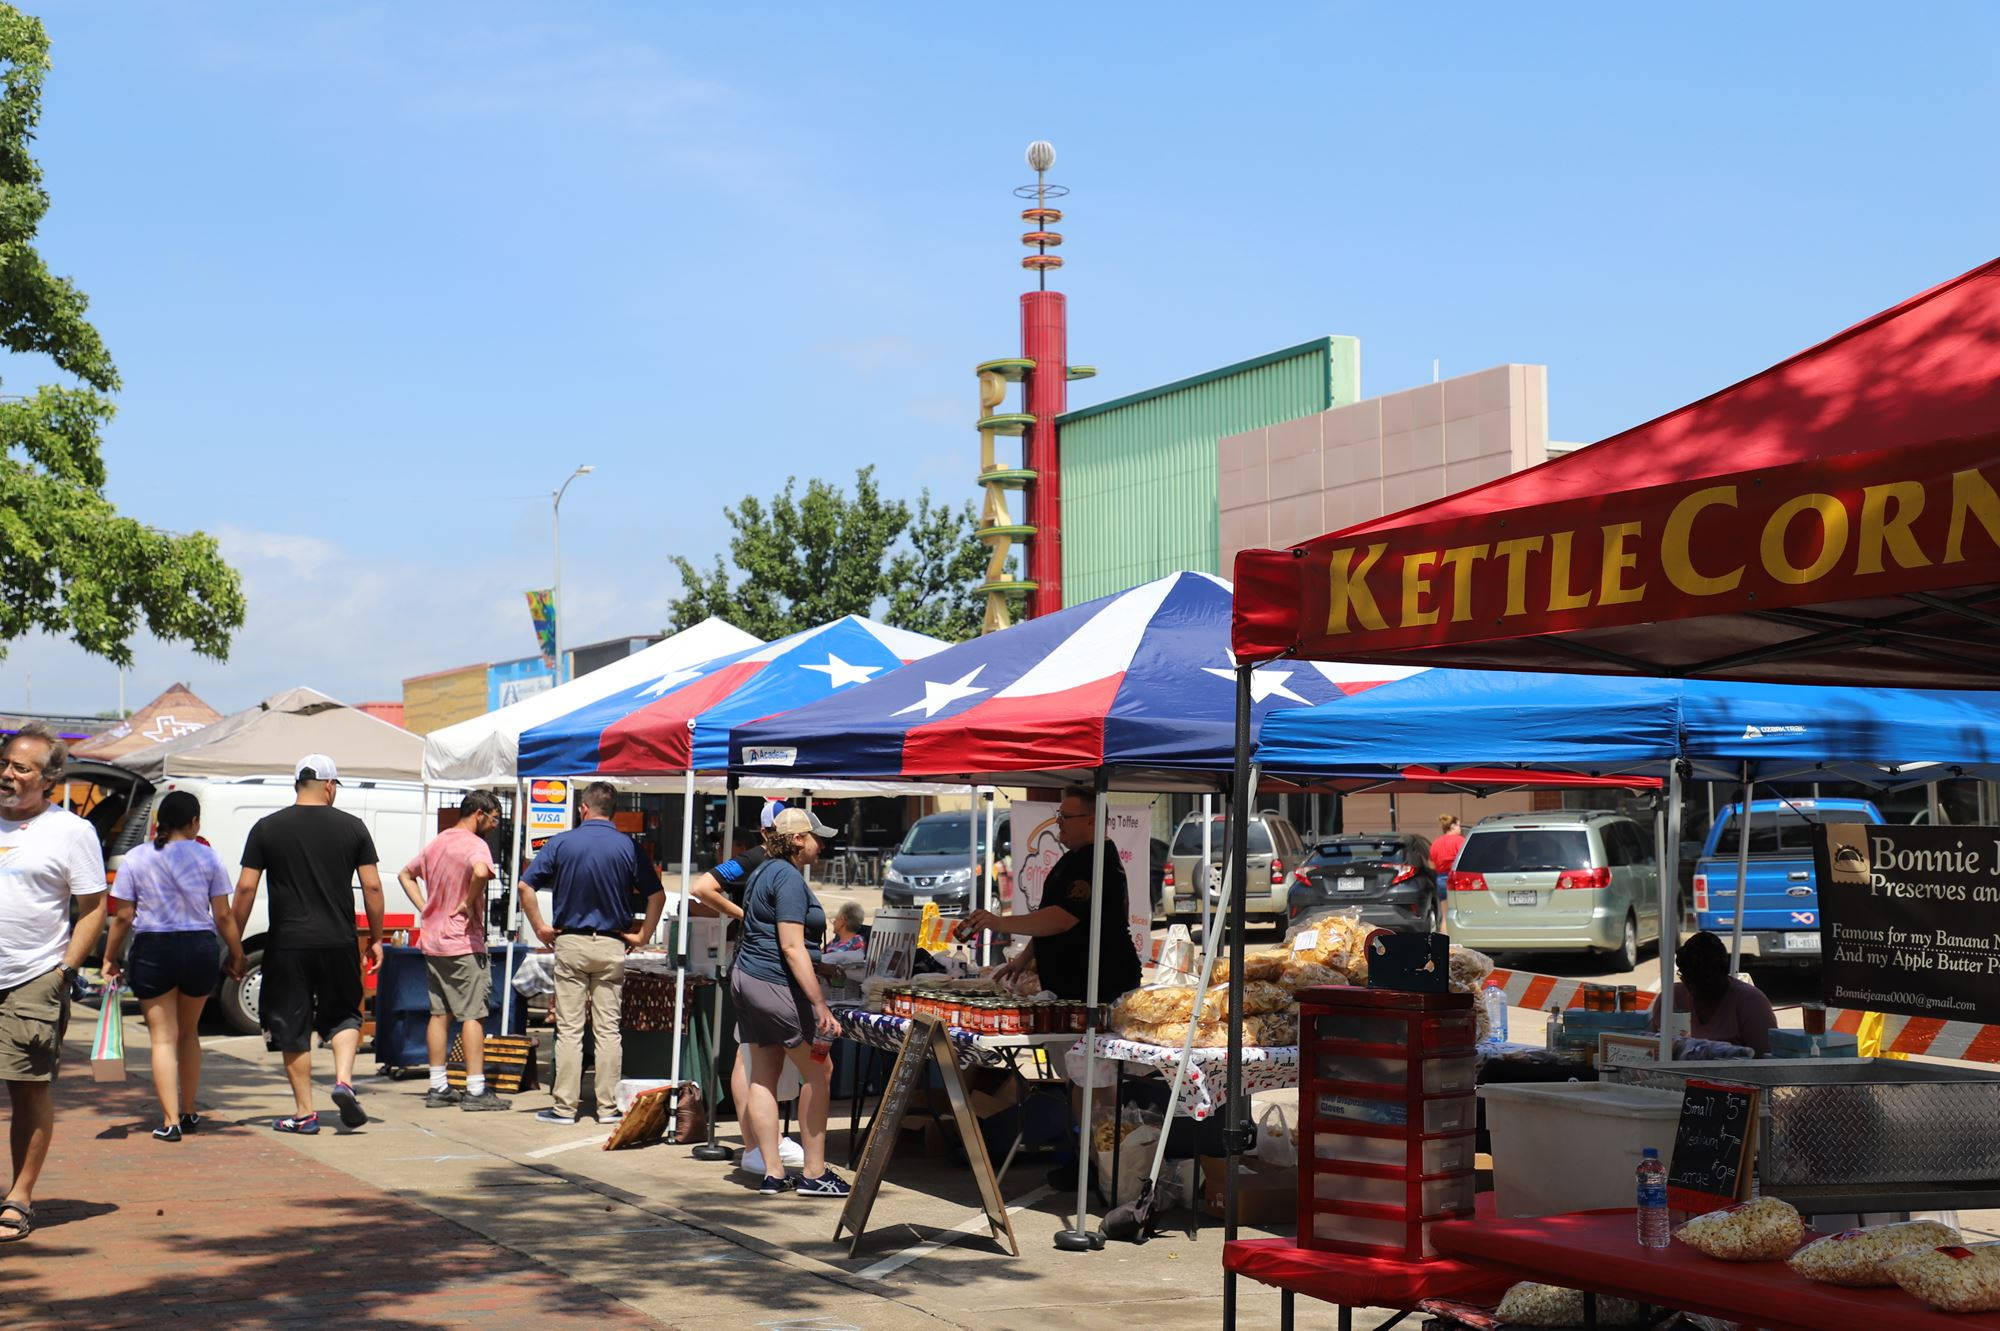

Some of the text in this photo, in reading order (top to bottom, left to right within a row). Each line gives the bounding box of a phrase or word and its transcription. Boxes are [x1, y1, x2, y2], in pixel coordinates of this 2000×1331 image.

[536, 813, 560, 823] VISA
[1117, 815, 1139, 829] Toffee
[1871, 836, 1980, 874] Bonnie
[1869, 873, 2000, 903] Preserves an
[1832, 923, 1884, 942] Famous
[1888, 926, 1907, 945] for
[1911, 933, 1931, 948] my
[1936, 929, 1989, 950] Banana
[1833, 945, 1863, 963] And
[1867, 952, 1888, 968] my
[1892, 949, 1933, 972] Apple
[1937, 953, 1983, 973] Butter
[1321, 1103, 1345, 1114] Gloves
[1683, 1096, 1715, 1117] Small
